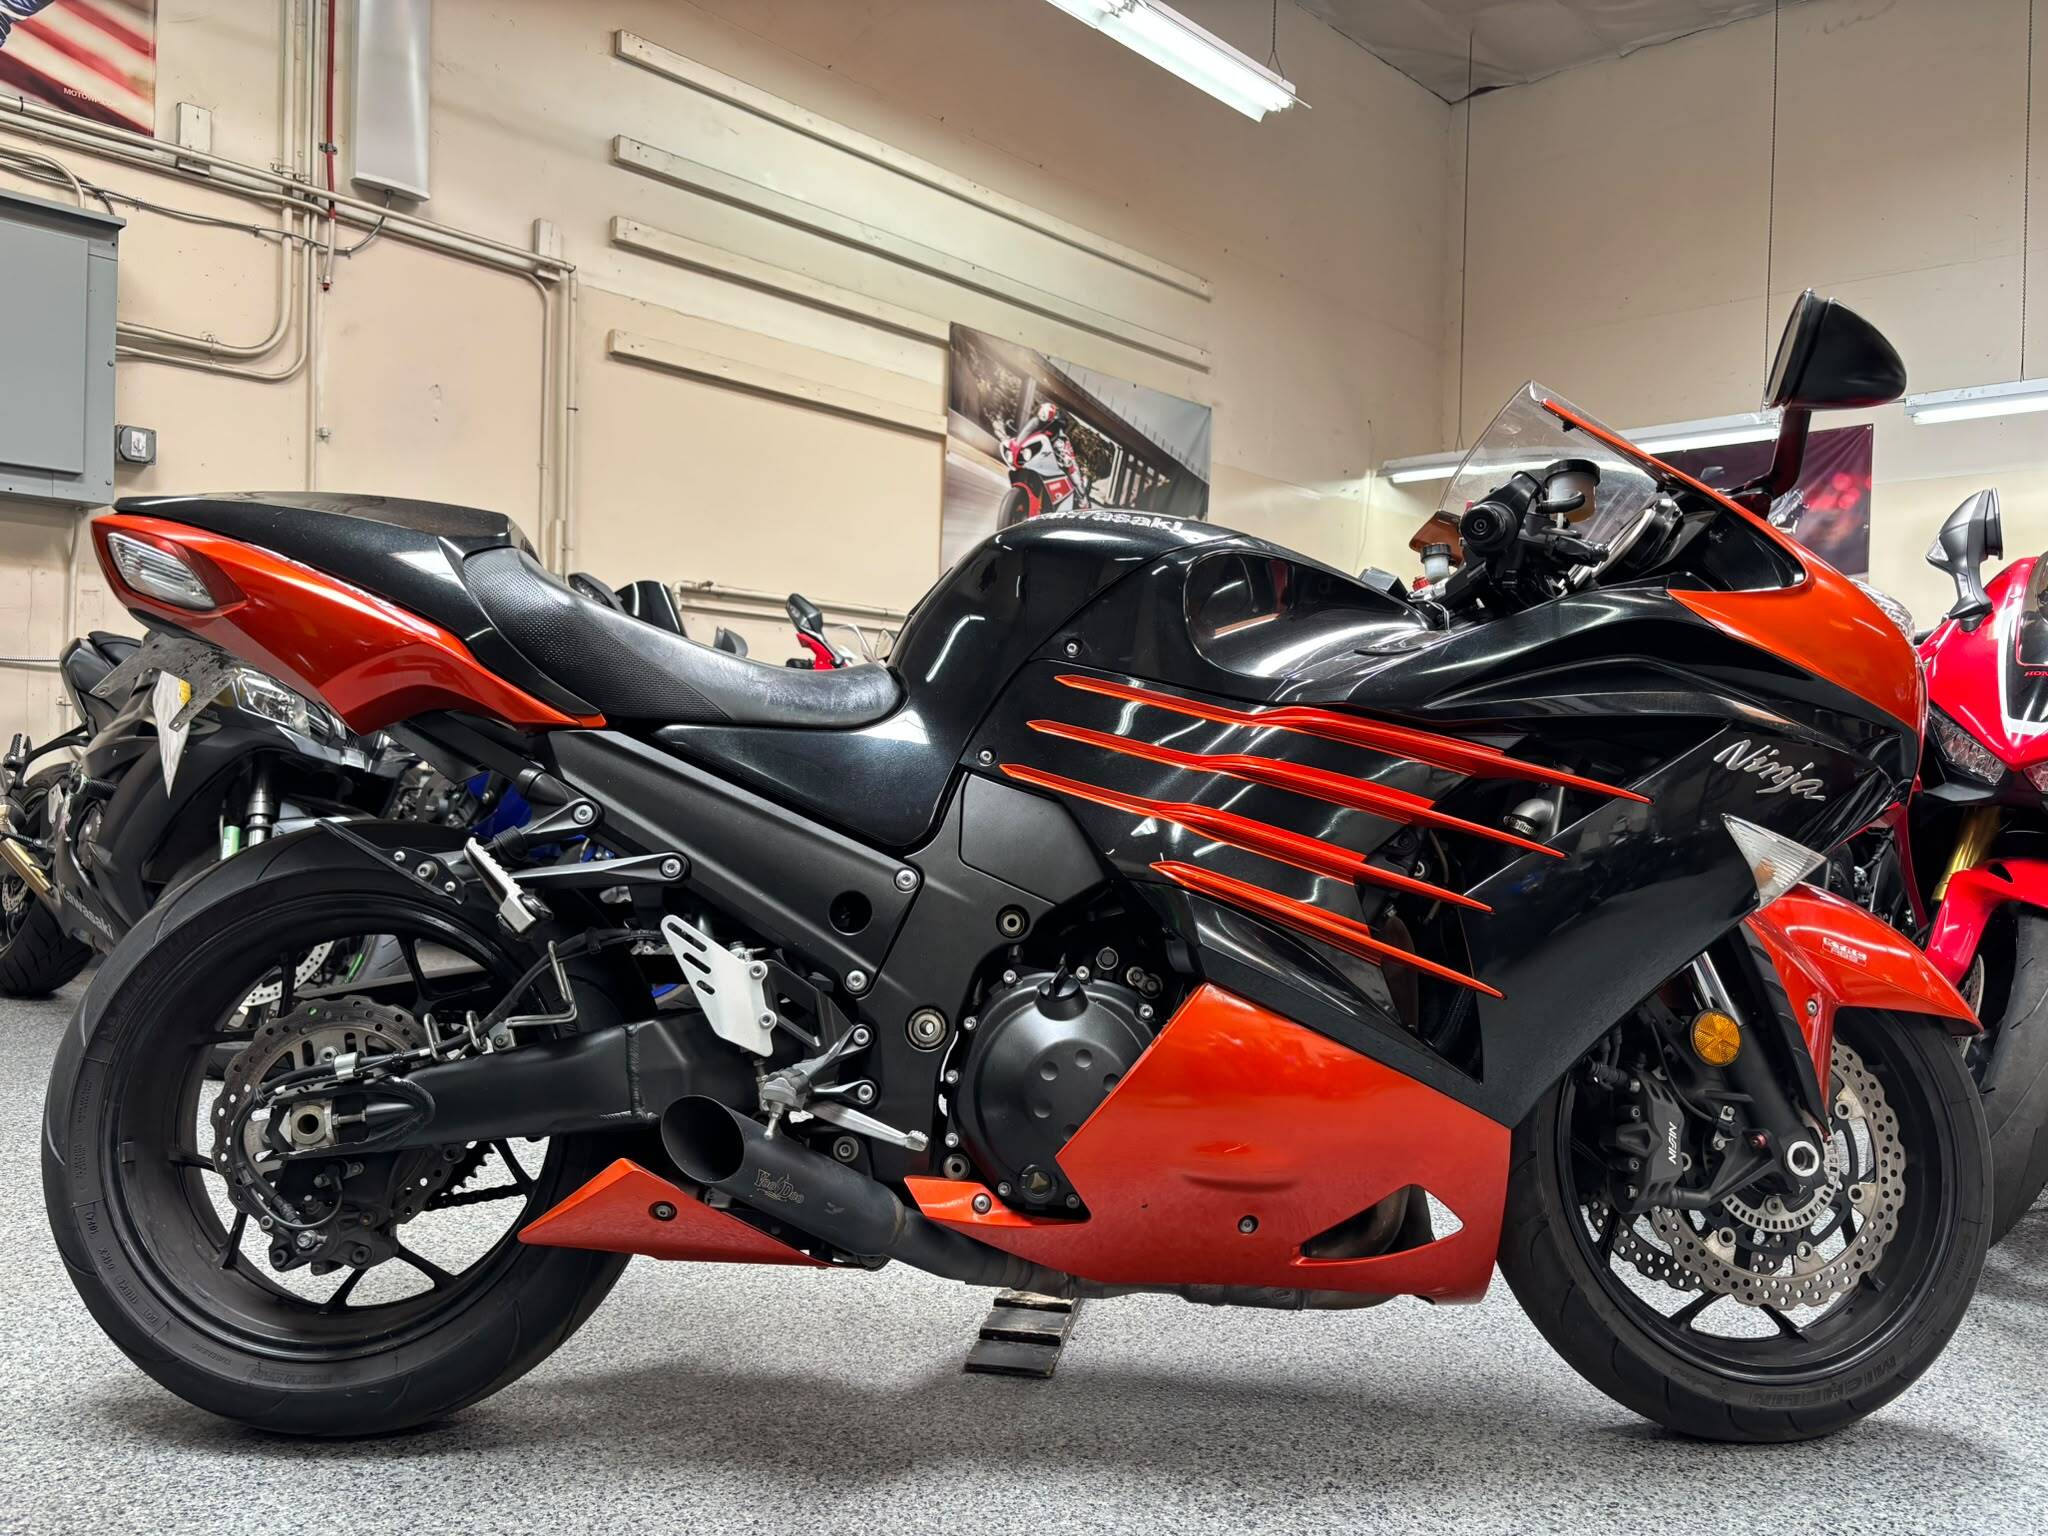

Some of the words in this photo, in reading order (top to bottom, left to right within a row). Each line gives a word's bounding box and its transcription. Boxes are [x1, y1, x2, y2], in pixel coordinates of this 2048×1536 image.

[1713, 739, 1826, 801] Ninja
[57, 880, 114, 940] Kawasaki
[1668, 1121, 1677, 1165] NISSIN
